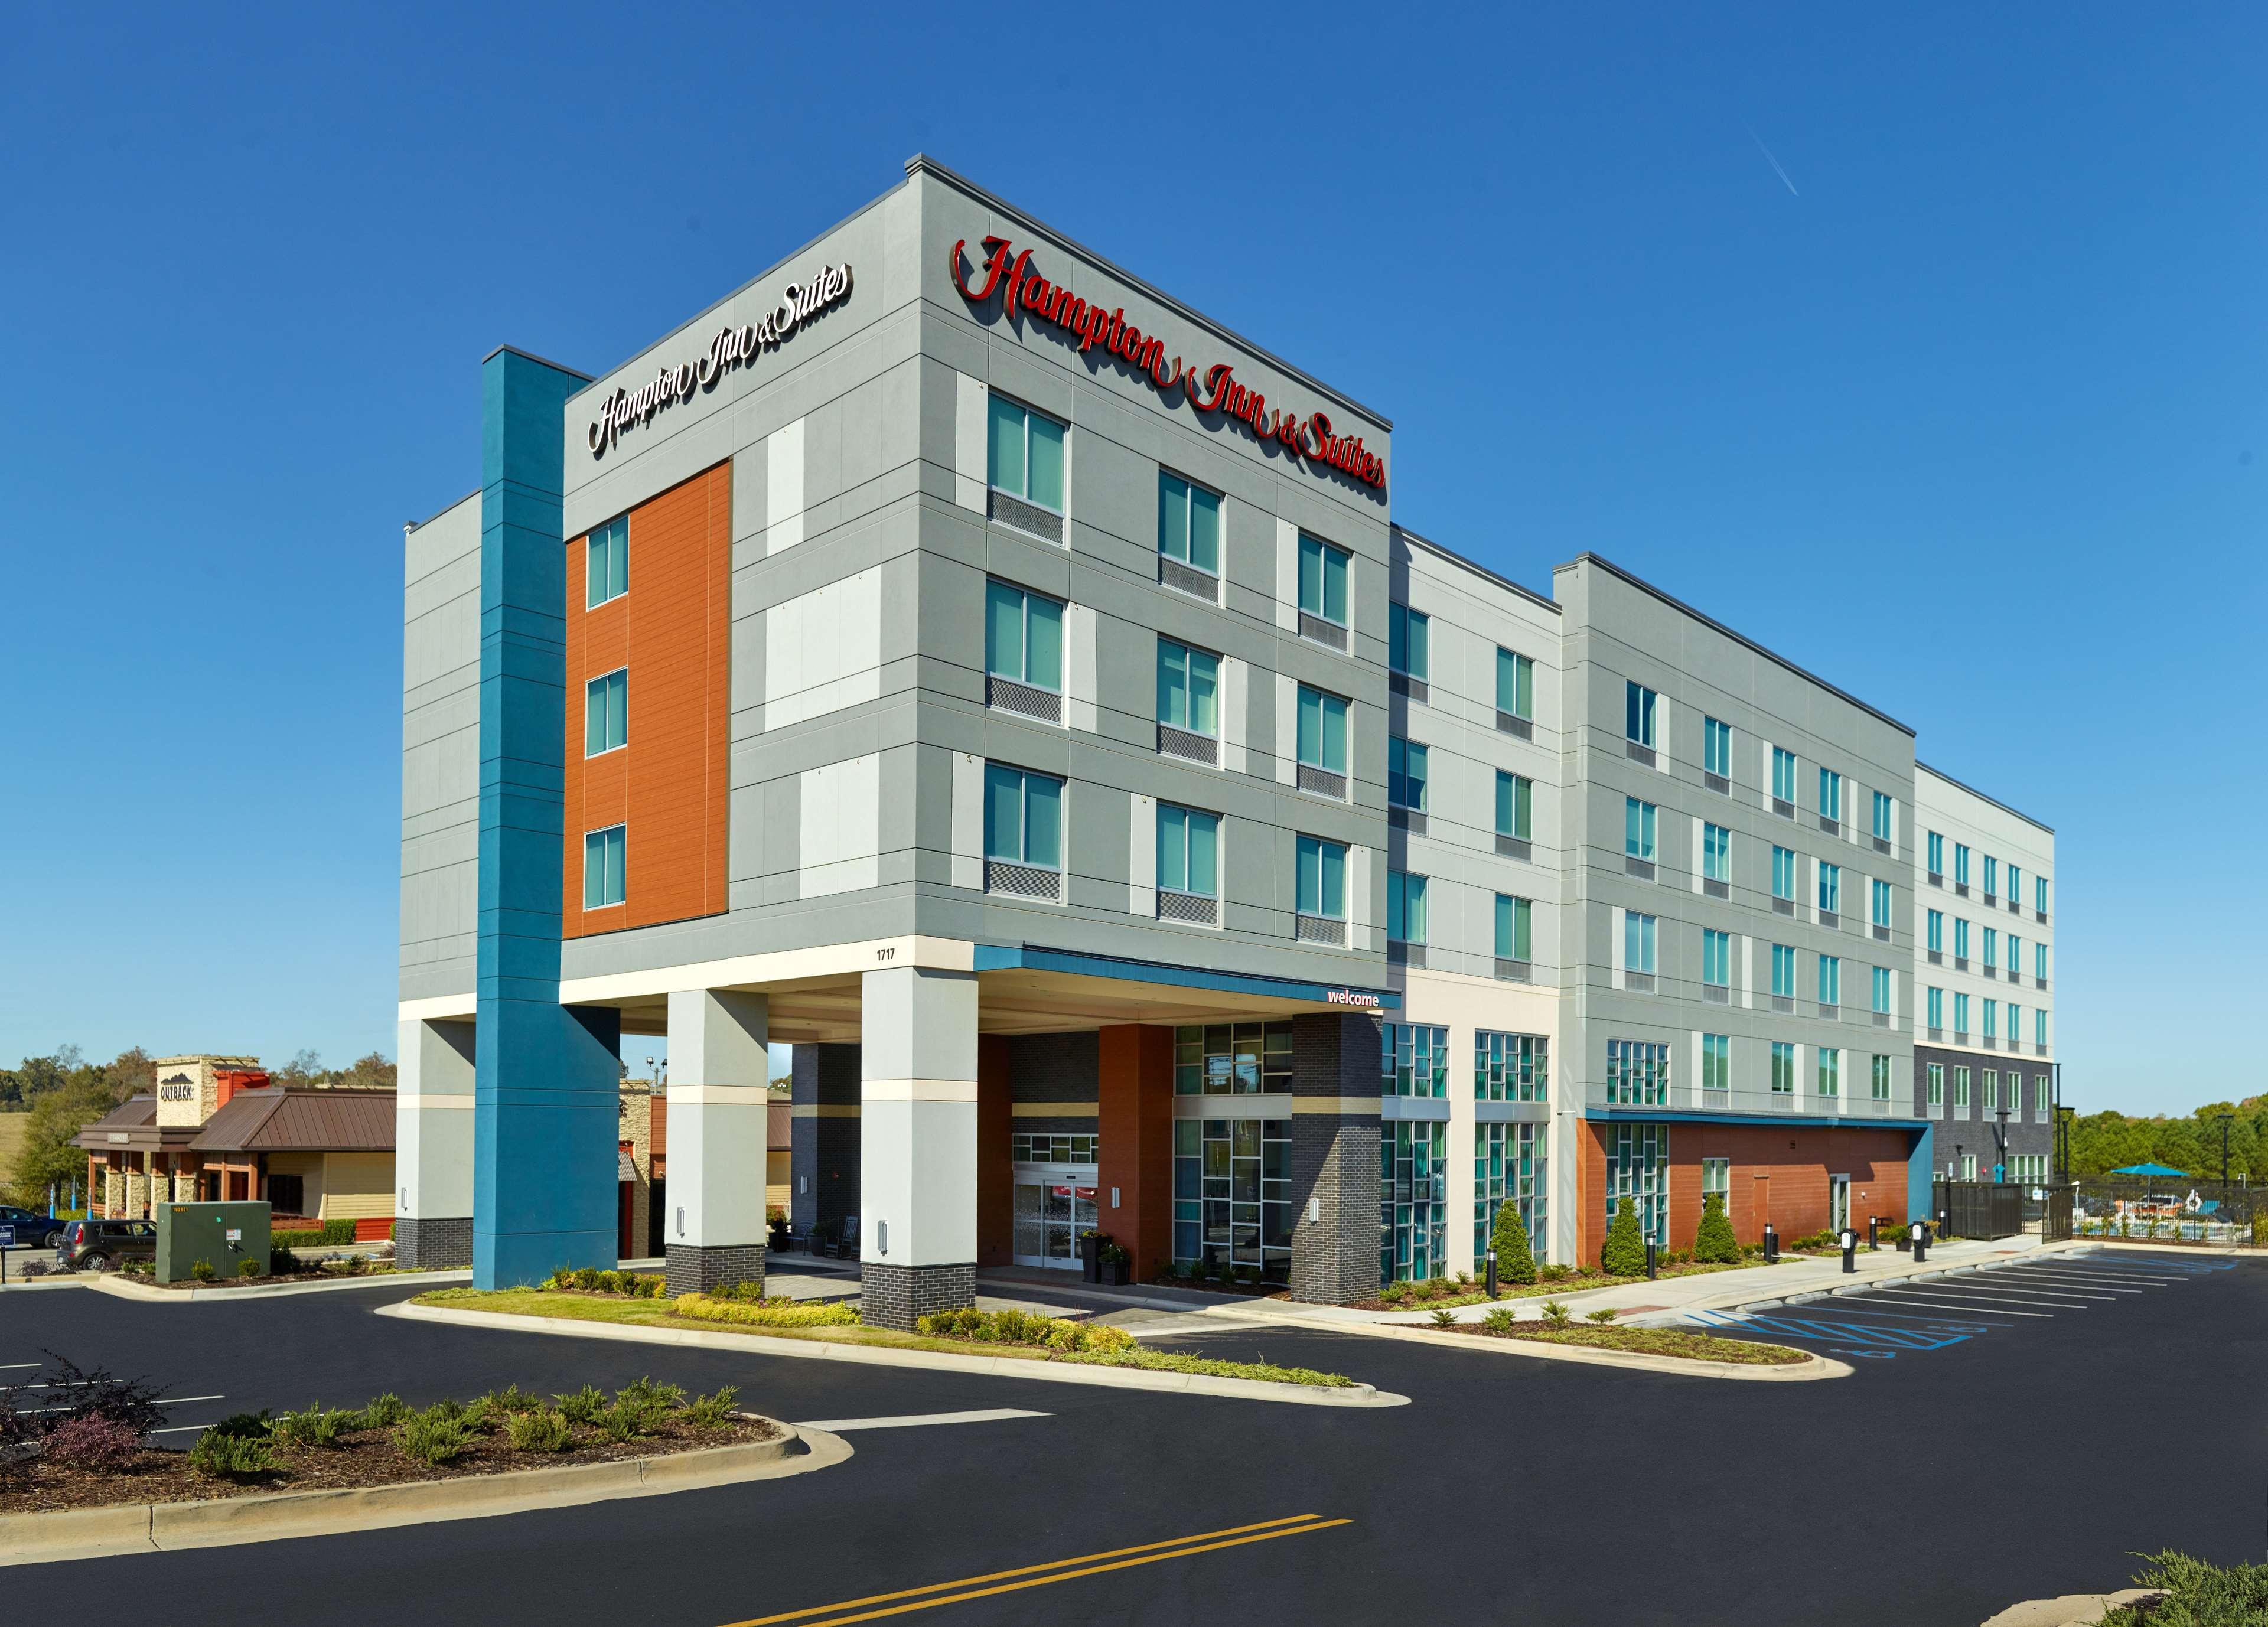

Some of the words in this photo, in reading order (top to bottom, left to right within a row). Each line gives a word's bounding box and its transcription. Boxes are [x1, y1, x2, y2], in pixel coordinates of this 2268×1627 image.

[588, 361, 695, 453] Hampton
[697, 322, 758, 384] Inn
[758, 312, 775, 343] &
[774, 263, 849, 333] Suites
[950, 236, 1181, 387] Hampton
[1185, 364, 1280, 438] Inn
[1280, 413, 1303, 456] &
[1301, 412, 1385, 488] Suites
[877, 948, 895, 961] 1717
[1328, 989, 1379, 1007] welcome
[161, 1085, 191, 1101] OUTBACK
